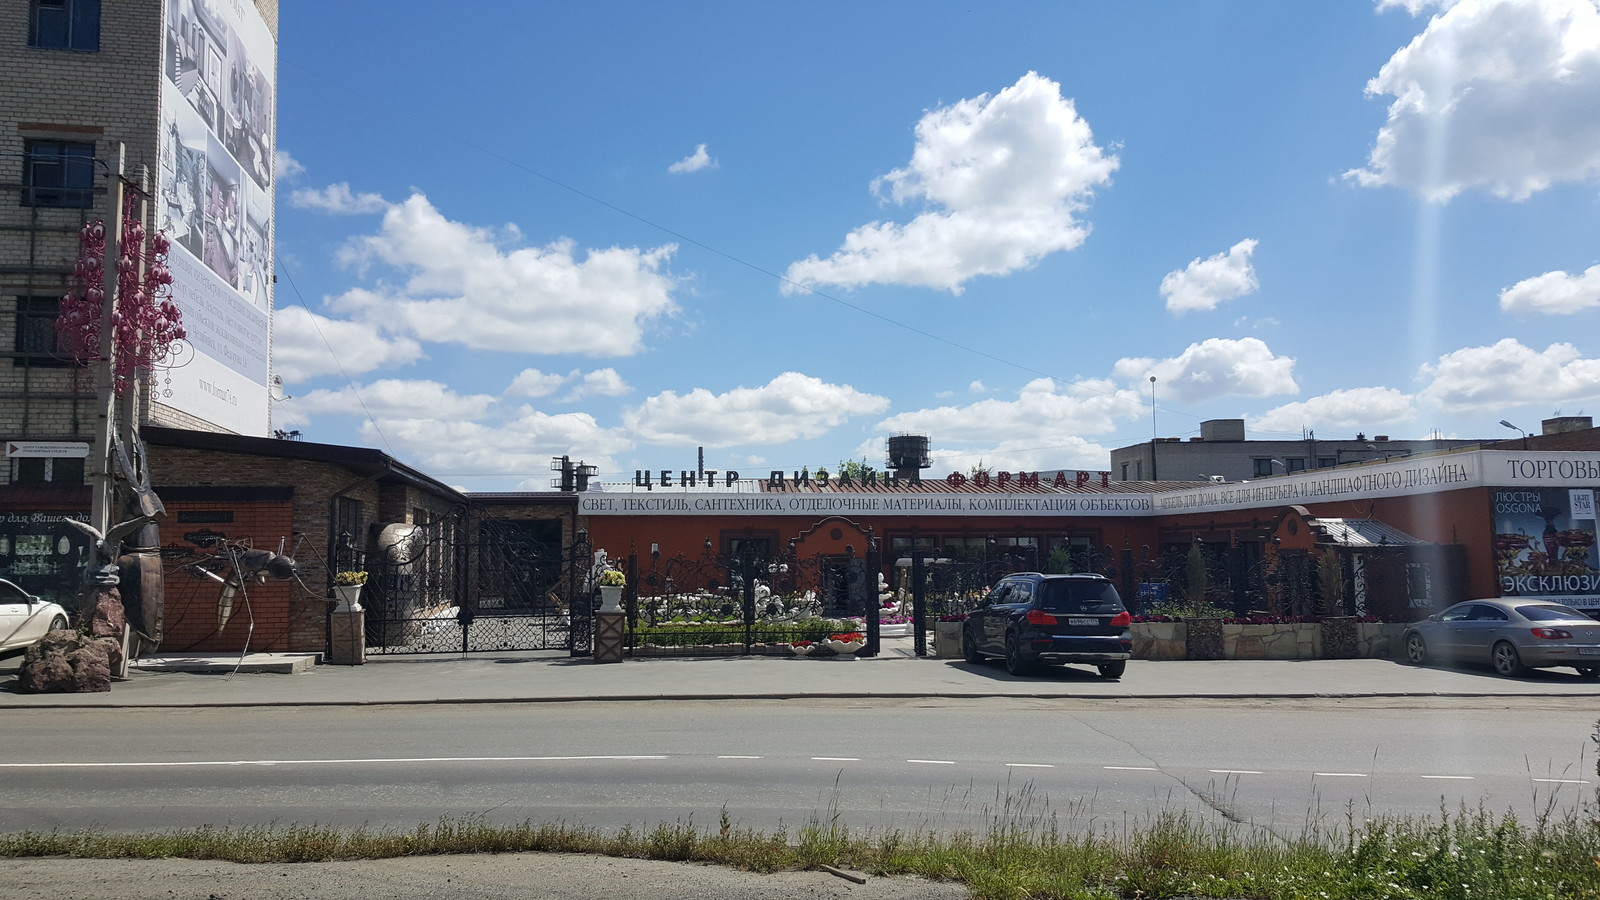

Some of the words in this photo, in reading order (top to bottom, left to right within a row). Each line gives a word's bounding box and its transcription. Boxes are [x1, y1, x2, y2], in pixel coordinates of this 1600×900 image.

[635, 470, 740, 491] ЦЕНТР
[1160, 495, 1184, 510] МЕБЕЛЬ
[1184, 494, 1197, 509] ДЛЯ
[1220, 490, 1235, 505] ВСЕ
[1235, 488, 1251, 505] ДЛЯ
[1251, 483, 1299, 502] ИНТЕРЬЕРА
[1300, 481, 1309, 497] И
[1310, 470, 1402, 497] ЛАНДШАФТНОГО
[1404, 459, 1468, 491] ДИЗАЙНА
[1495, 491, 1541, 503] ЛЮСТРЫ
[582, 498, 618, 512] СВЕТ,
[622, 498, 692, 512] ТЕКСТИЛЬ,
[694, 498, 786, 512] САНТЕХНИКА,
[788, 498, 880, 511] ОТДЕЛОЧНЫЕ
[882, 498, 966, 512] МАТЕРИАЛЫ,
[969, 498, 1077, 512] КОМПЛЕКТАЦИЯ
[1080, 498, 1150, 511] ОБЪЕКТОВ
[1496, 503, 1543, 514] OSGONA
[1574, 501, 1591, 509] STAR
[7, 512, 29, 524] для
